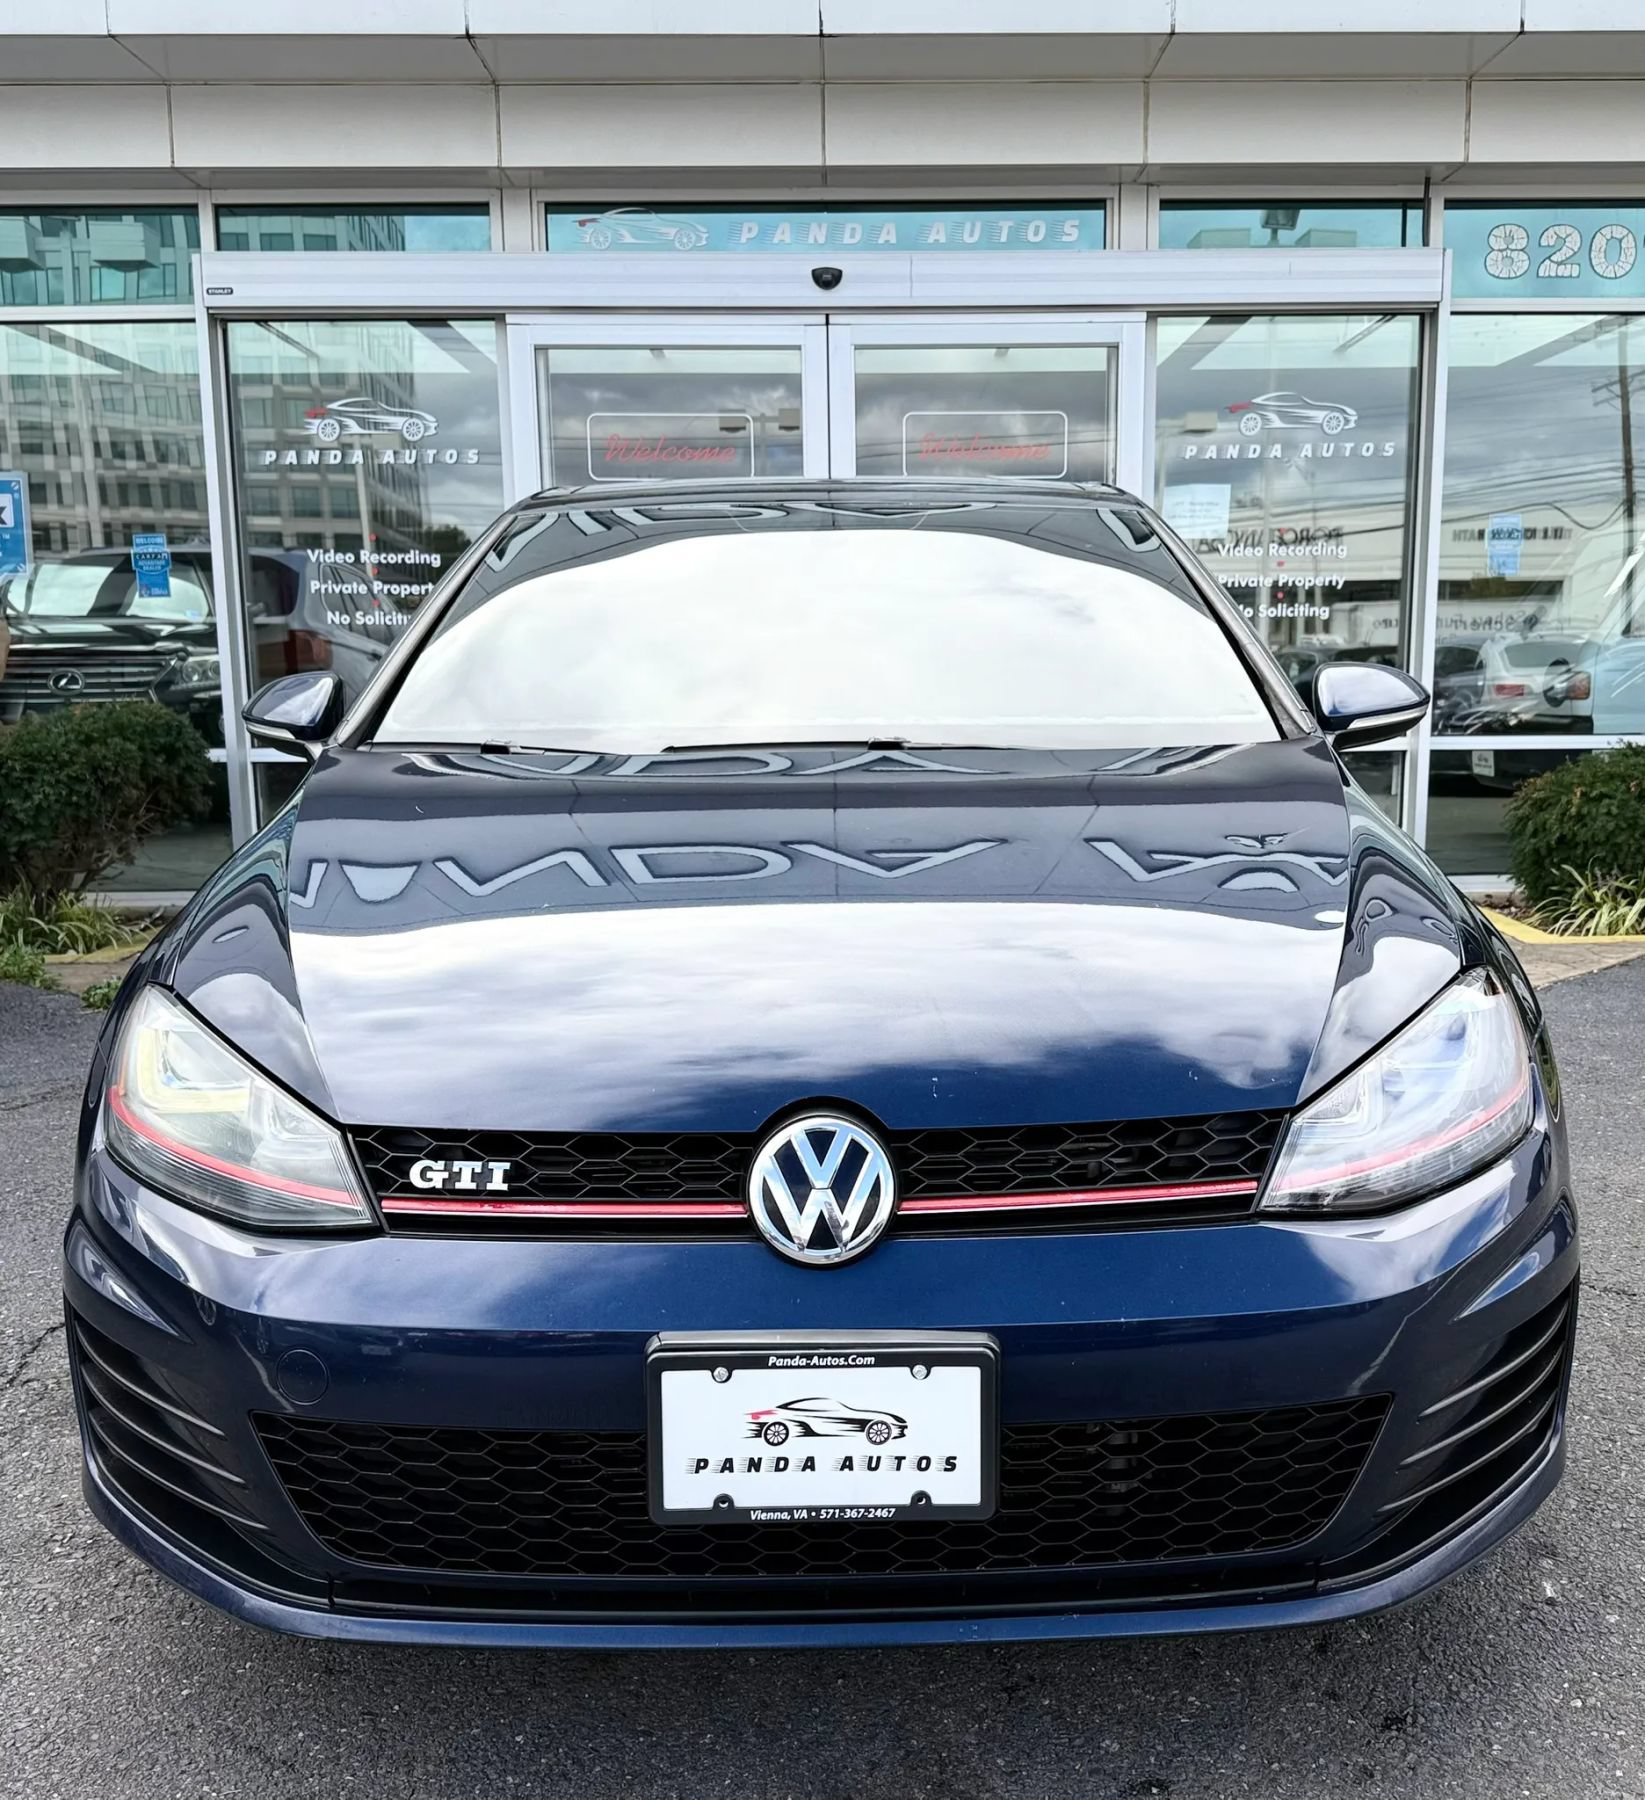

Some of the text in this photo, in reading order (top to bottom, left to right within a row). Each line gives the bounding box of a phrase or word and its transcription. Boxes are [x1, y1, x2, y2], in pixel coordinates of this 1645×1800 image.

[736, 219, 1081, 245] PANDA AUTOS
[1484, 223, 1645, 280] 820
[262, 449, 480, 465] PANDA AUTOS
[604, 433, 737, 464] Welcome
[1183, 442, 1396, 460] PANDA AUTOS
[307, 549, 442, 567] Video Recording
[1217, 541, 1348, 559] Video Recording
[310, 580, 435, 598] Private Propert
[1218, 574, 1345, 590] Private Property
[327, 610, 411, 625] No Soliciti
[1258, 602, 1330, 620] Soliciting
[409, 1159, 512, 1192] GTI
[768, 1354, 876, 1368] Panda-Autos.Com
[690, 1455, 957, 1475] PANDA AUTOS
[750, 1508, 896, 1521] Vienna, VA 571-367-2467
